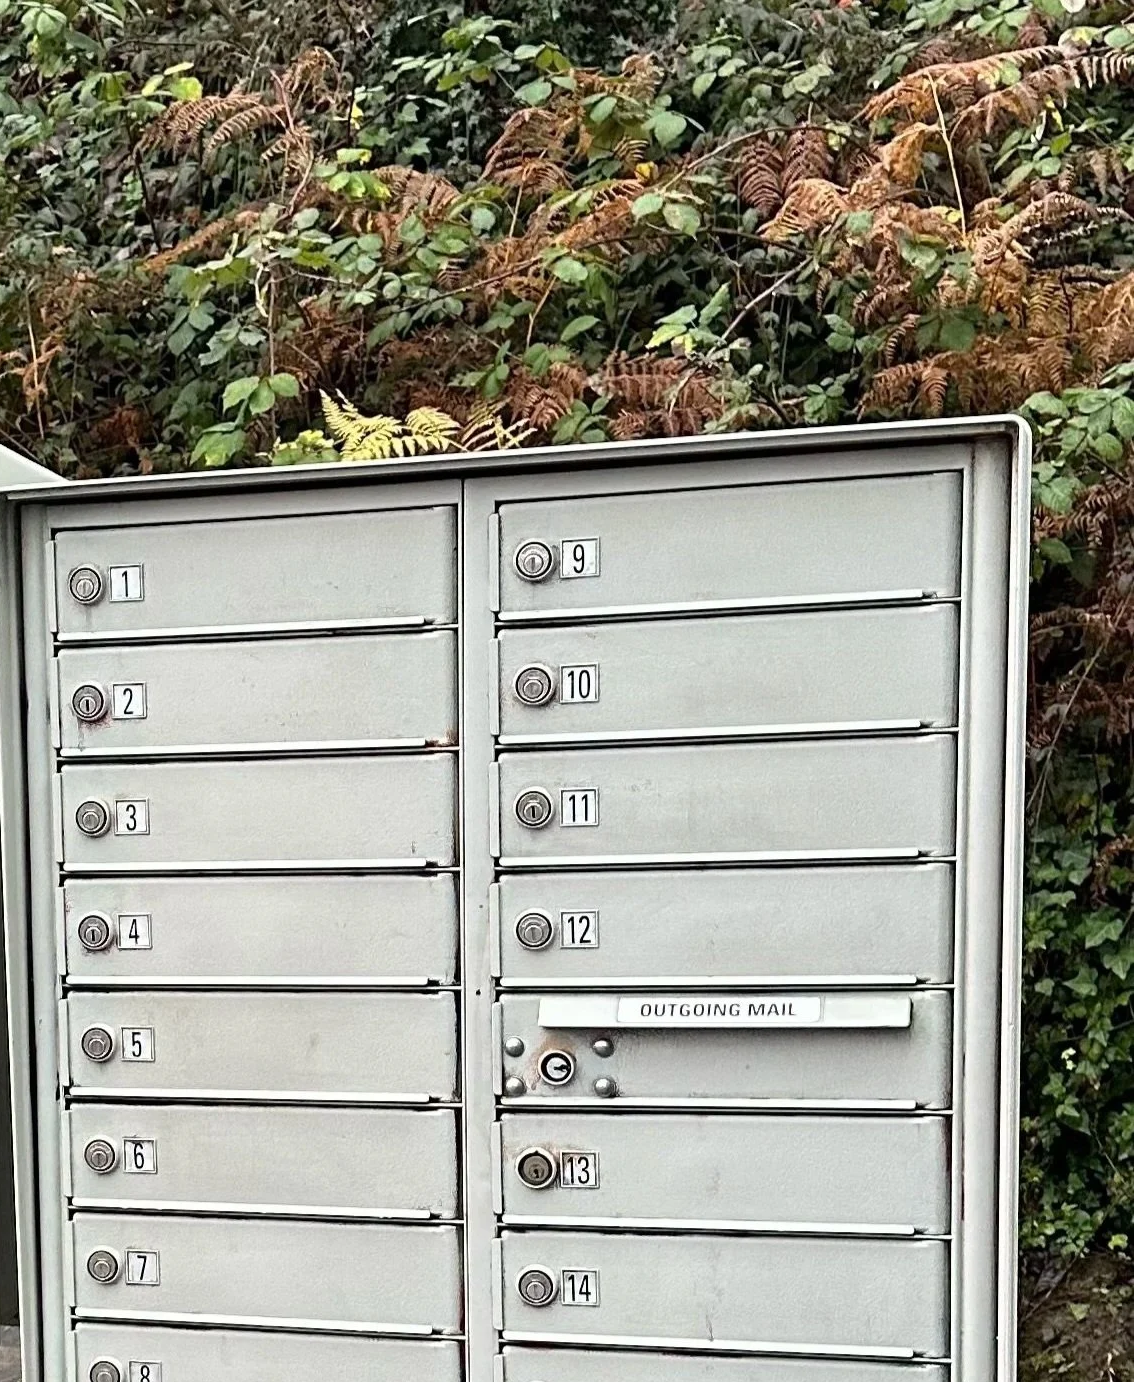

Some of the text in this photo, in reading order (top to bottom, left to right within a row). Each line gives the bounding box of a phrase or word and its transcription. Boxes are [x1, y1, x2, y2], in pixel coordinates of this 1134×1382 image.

[573, 544, 585, 573] 9
[122, 571, 129, 597] 1
[568, 671, 590, 699] 10
[123, 688, 133, 715] 2
[127, 805, 136, 831] 3
[569, 794, 589, 822] 11
[129, 919, 140, 944] 4
[568, 917, 591, 943] 12
[641, 1003, 796, 1017] OUTGOING MAIL
[132, 1032, 142, 1057] 5
[134, 1142, 144, 1168] 6
[567, 1157, 590, 1183] 13
[137, 1255, 147, 1280] 7
[568, 1274, 591, 1301] 14
